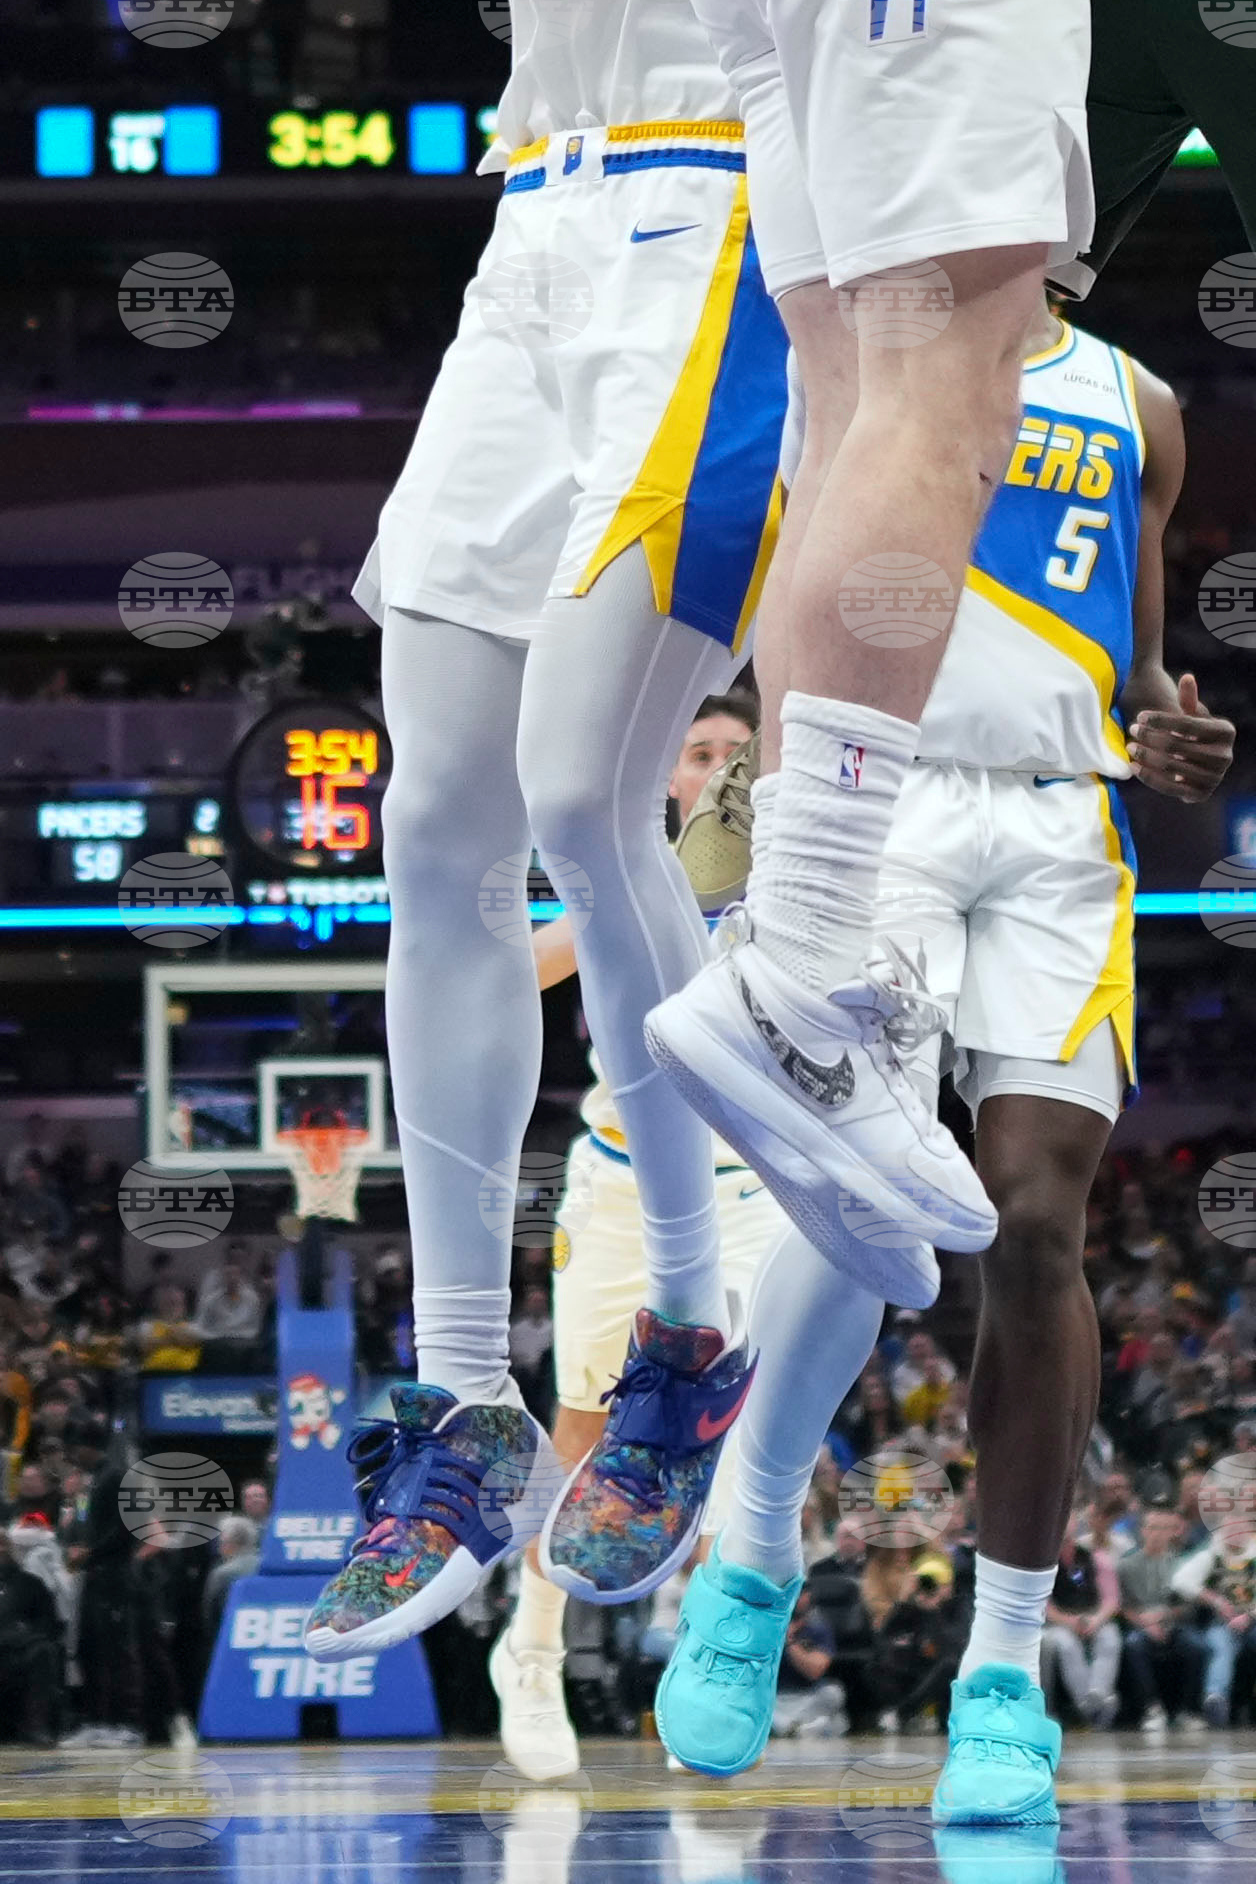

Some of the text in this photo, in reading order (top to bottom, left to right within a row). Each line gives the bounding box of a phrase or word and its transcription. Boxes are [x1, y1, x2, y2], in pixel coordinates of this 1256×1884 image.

[268, 110, 394, 169] 3:54
[1063, 372, 1119, 397] LUCAS OIL
[1045, 505, 1110, 593] 5
[301, 773, 370, 849] 16
[276, 1516, 355, 1538] BELLE
[284, 1540, 344, 1560] TIRE
[230, 1608, 311, 1649] BE
[250, 1655, 376, 1698] TIRE
